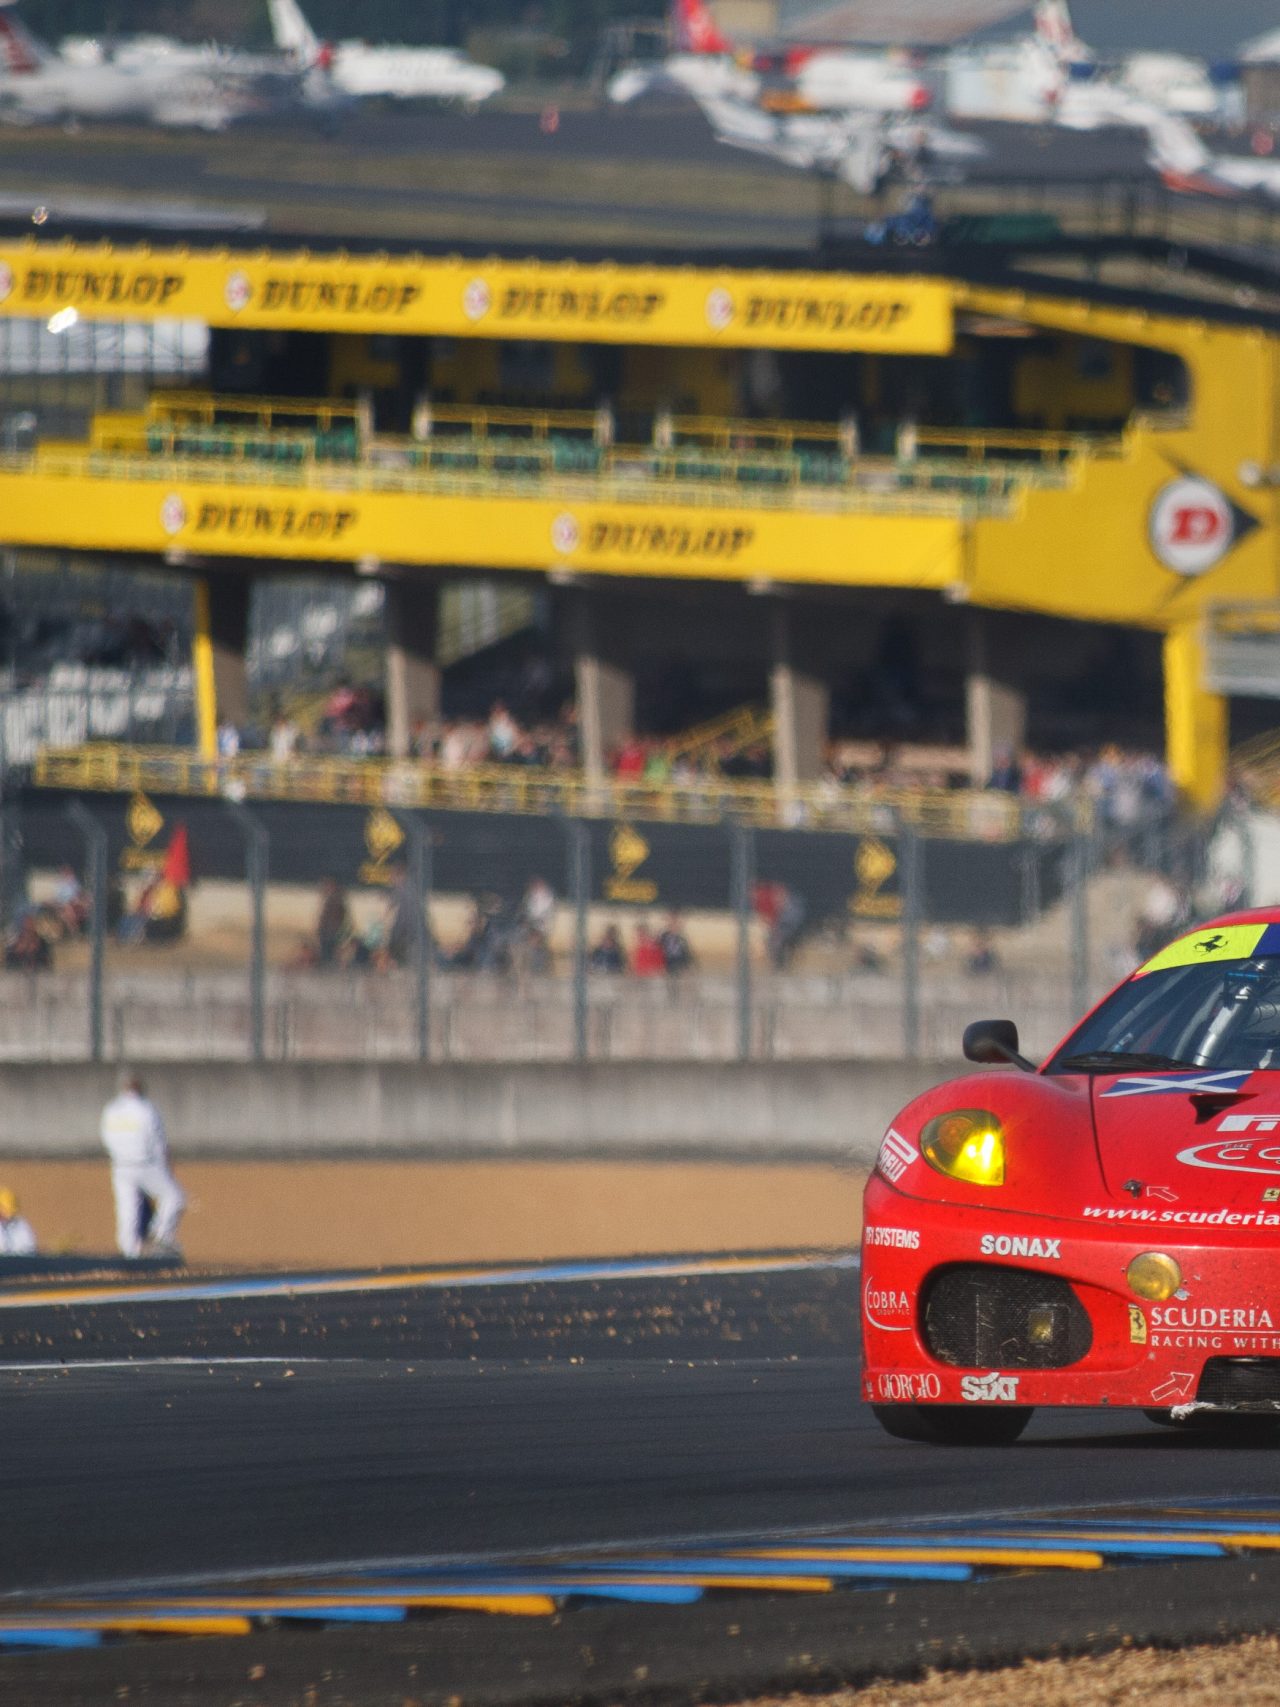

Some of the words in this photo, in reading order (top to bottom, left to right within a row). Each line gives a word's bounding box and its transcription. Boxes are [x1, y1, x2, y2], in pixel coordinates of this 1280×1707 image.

[22, 268, 185, 304] DUNLOP
[259, 277, 423, 313] DUNLOP
[500, 285, 666, 319] DUNLOP
[744, 295, 912, 330] DUNLOP
[195, 503, 358, 540] DUNLOP
[1168, 507, 1222, 545] D
[588, 527, 755, 557] DUNLOP
[875, 1227, 920, 1250] SYSTEMS
[980, 1234, 1061, 1259] SONAX
[868, 1291, 909, 1309] COBRA
[1151, 1307, 1273, 1328] SCUDERIA
[1151, 1335, 1222, 1349] RACING
[878, 1373, 941, 1399] GIORGIO
[961, 1372, 1020, 1400] SIXT
